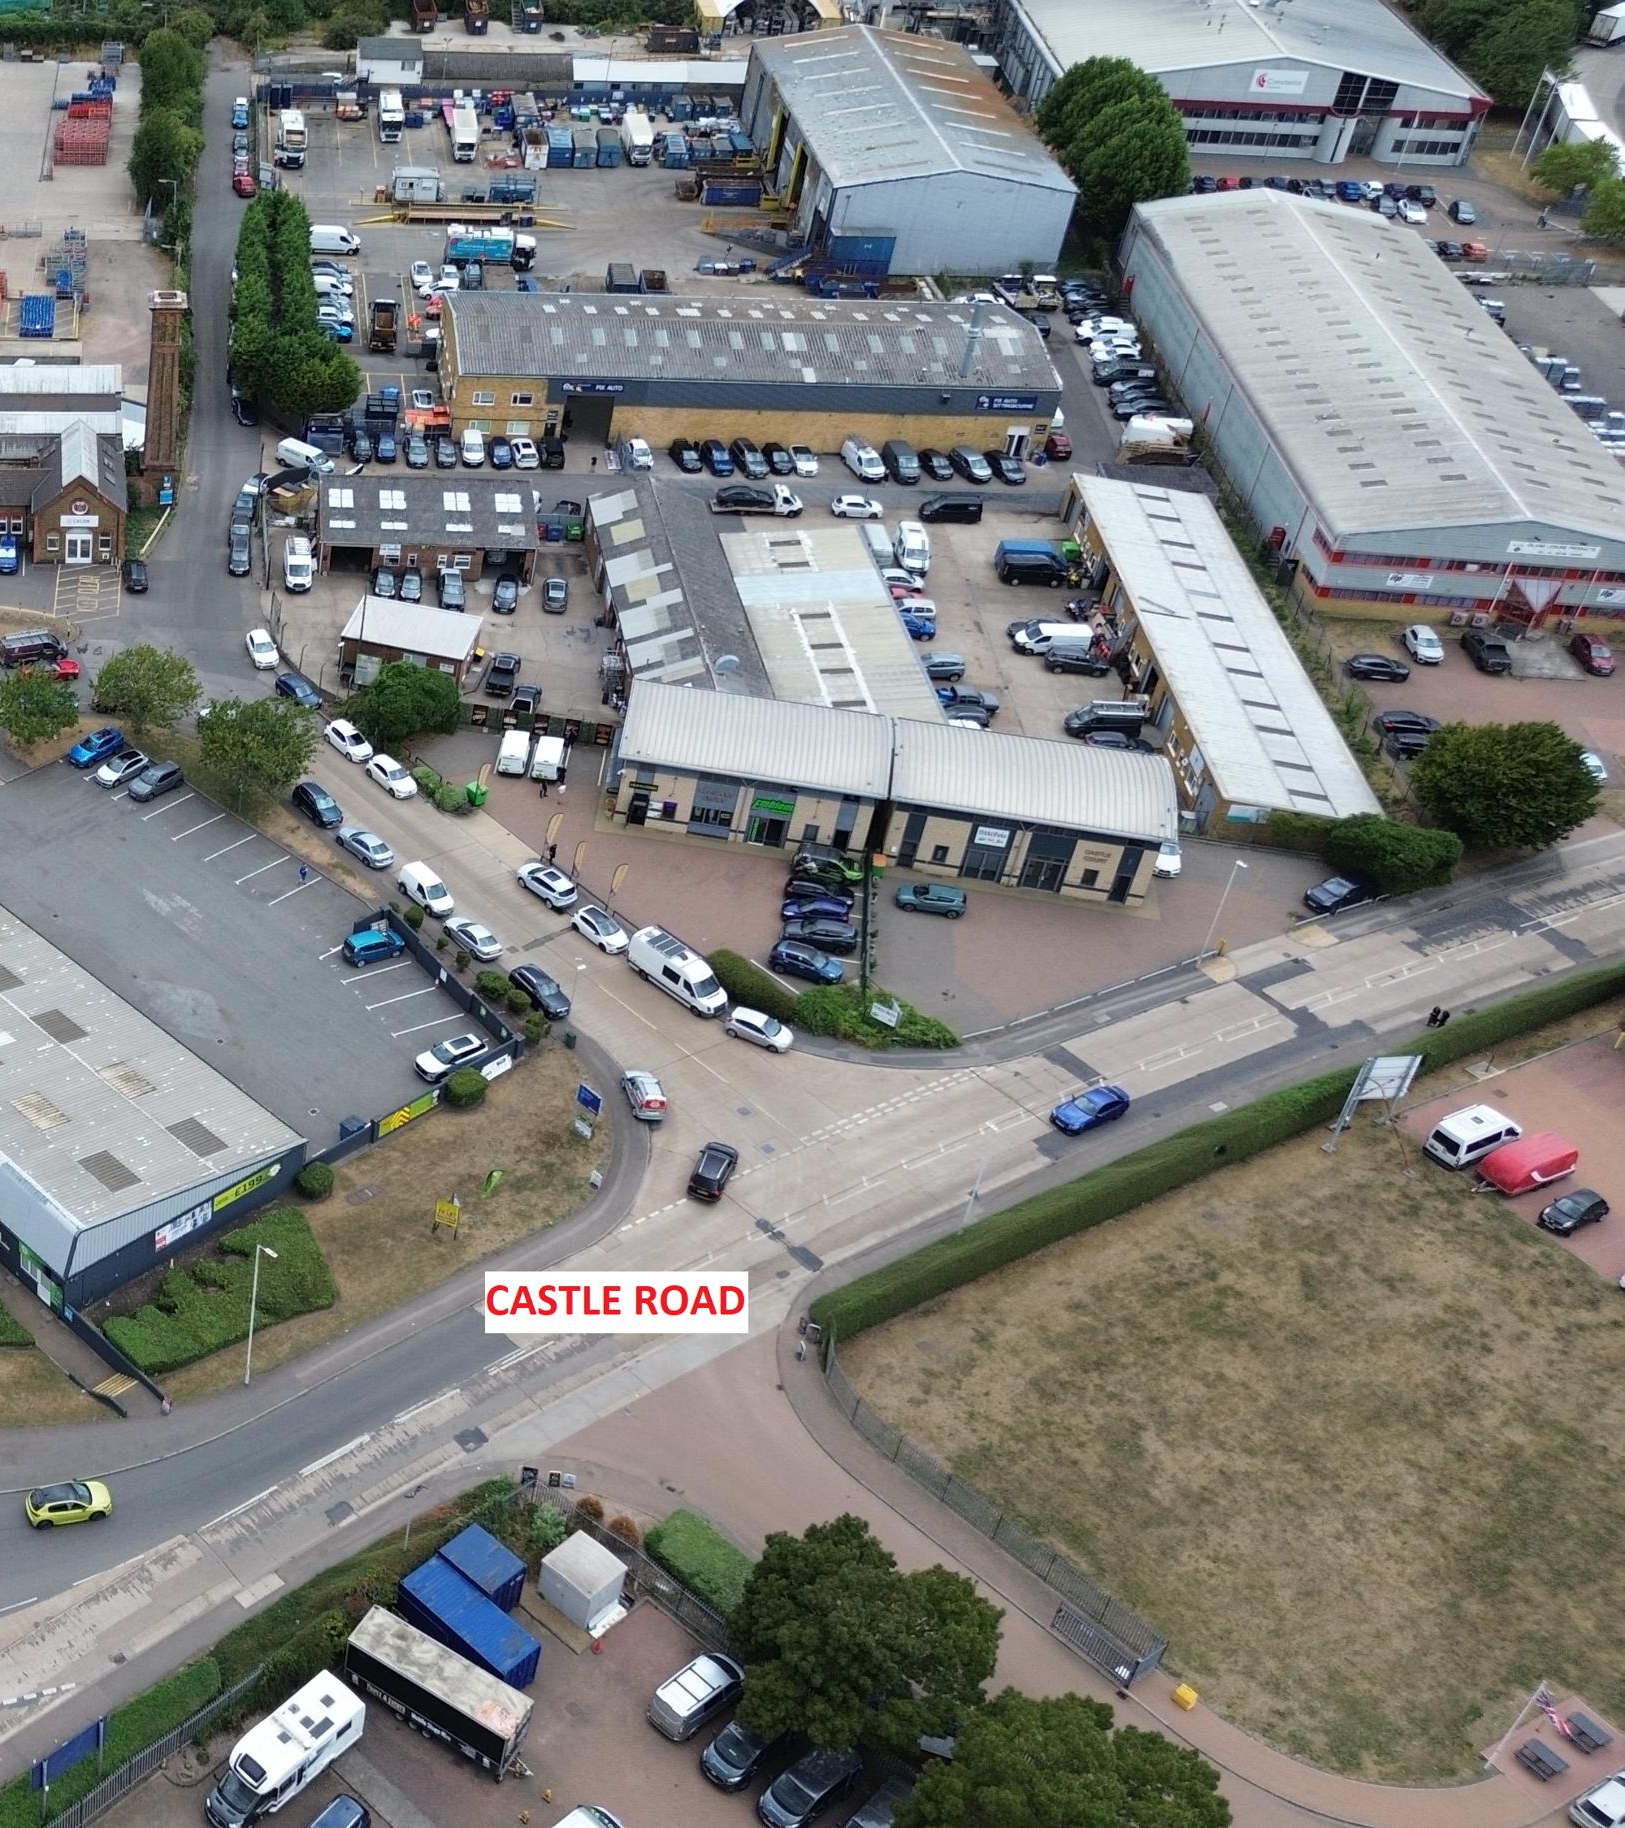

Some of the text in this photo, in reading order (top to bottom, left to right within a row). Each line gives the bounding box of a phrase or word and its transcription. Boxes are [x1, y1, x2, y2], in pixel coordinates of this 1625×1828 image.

[606, 384, 623, 392] AUTO
[1084, 849, 1112, 858] CASTLE
[234, 1175, 263, 1197] £199
